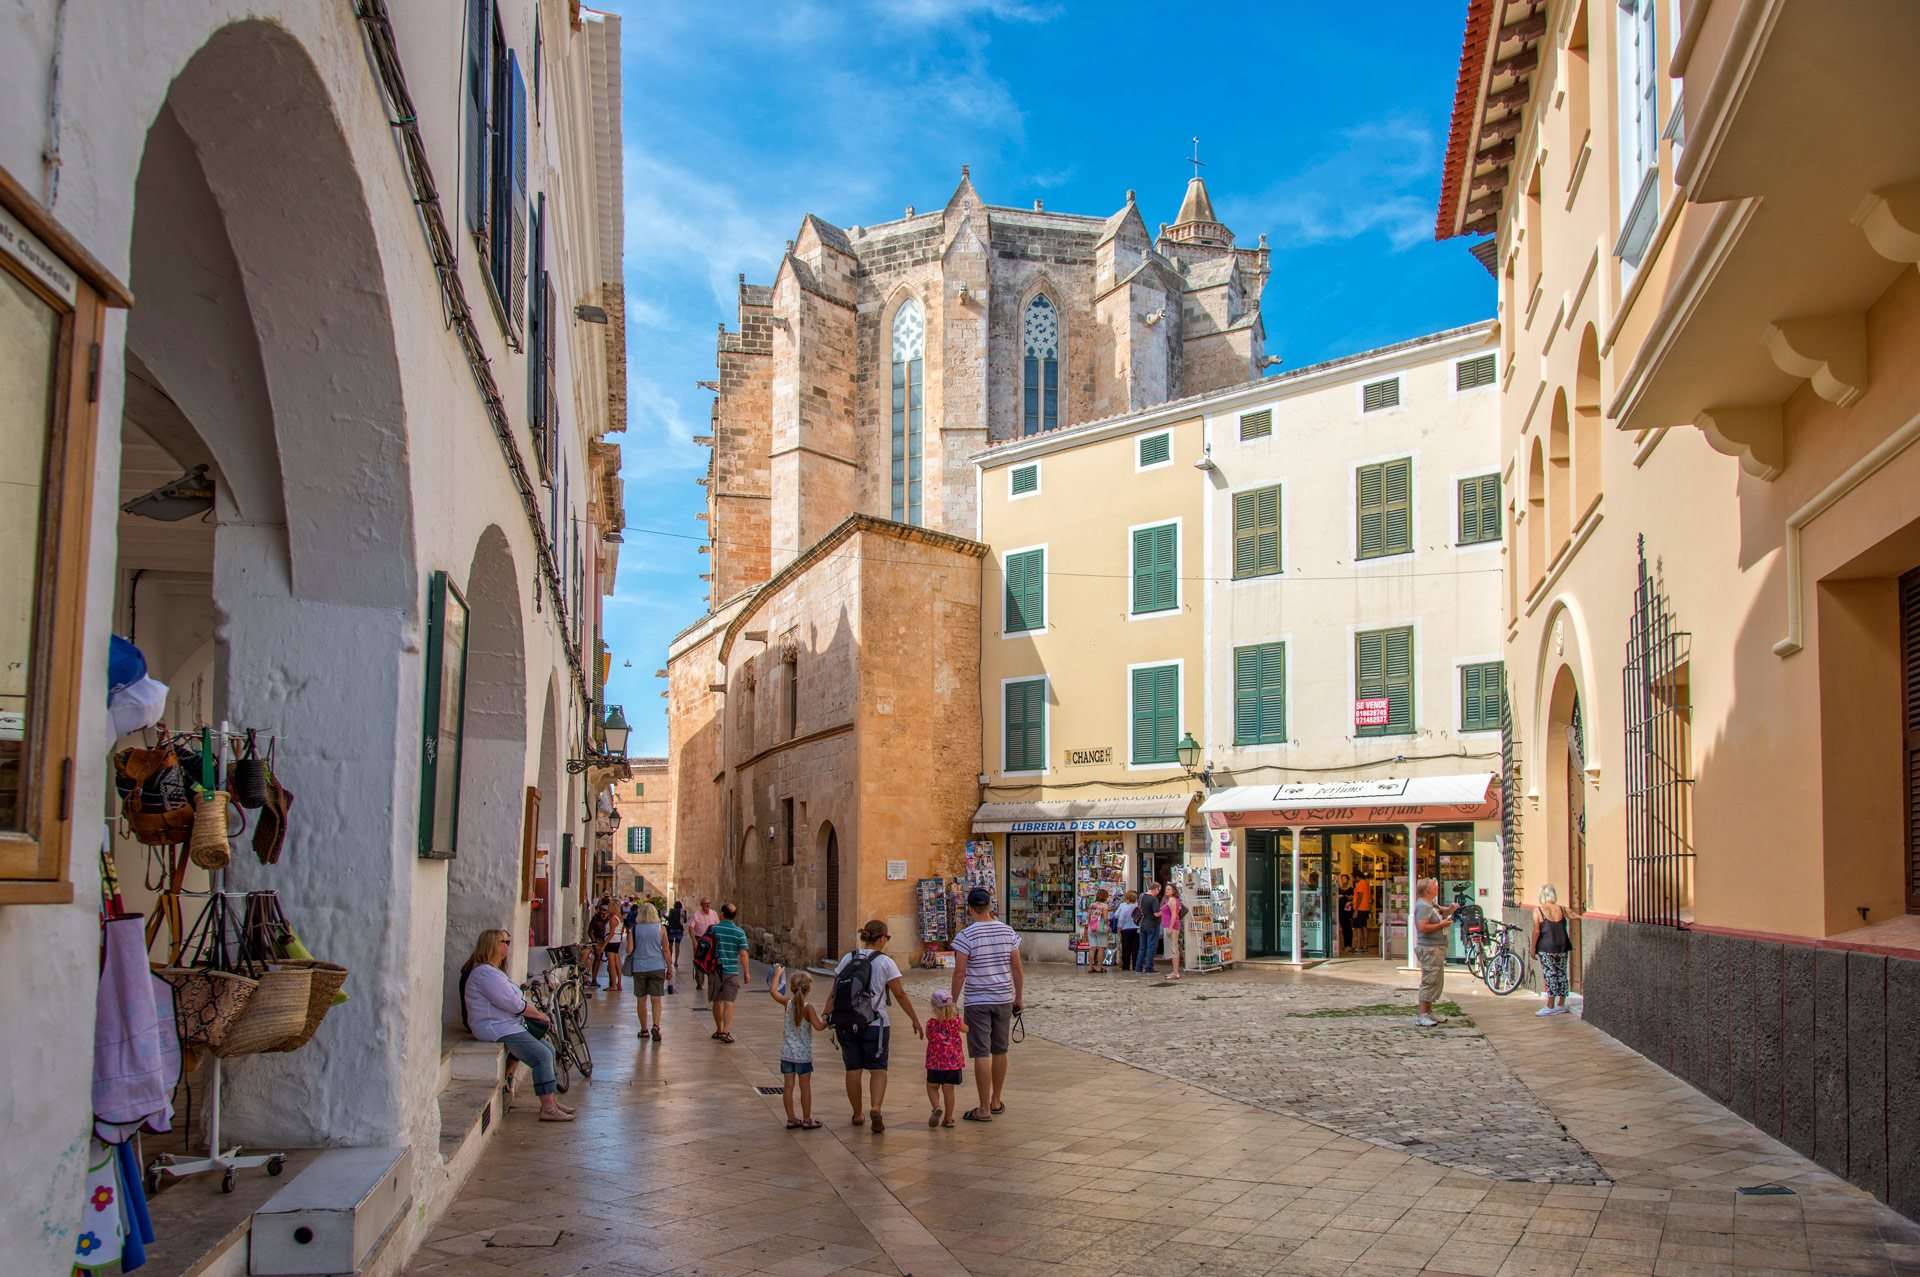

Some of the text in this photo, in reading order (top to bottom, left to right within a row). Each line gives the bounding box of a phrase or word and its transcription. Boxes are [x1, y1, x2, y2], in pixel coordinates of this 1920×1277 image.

[17, 239, 71, 293] Ciutadella
[1366, 701, 1387, 709] VENDE
[1072, 750, 1105, 764] CHANGE
[1314, 784, 1364, 796] perfums
[1011, 820, 1137, 831] LLIBRERIA D'ES RACO
[1301, 921, 1321, 929] OLTAIRE
